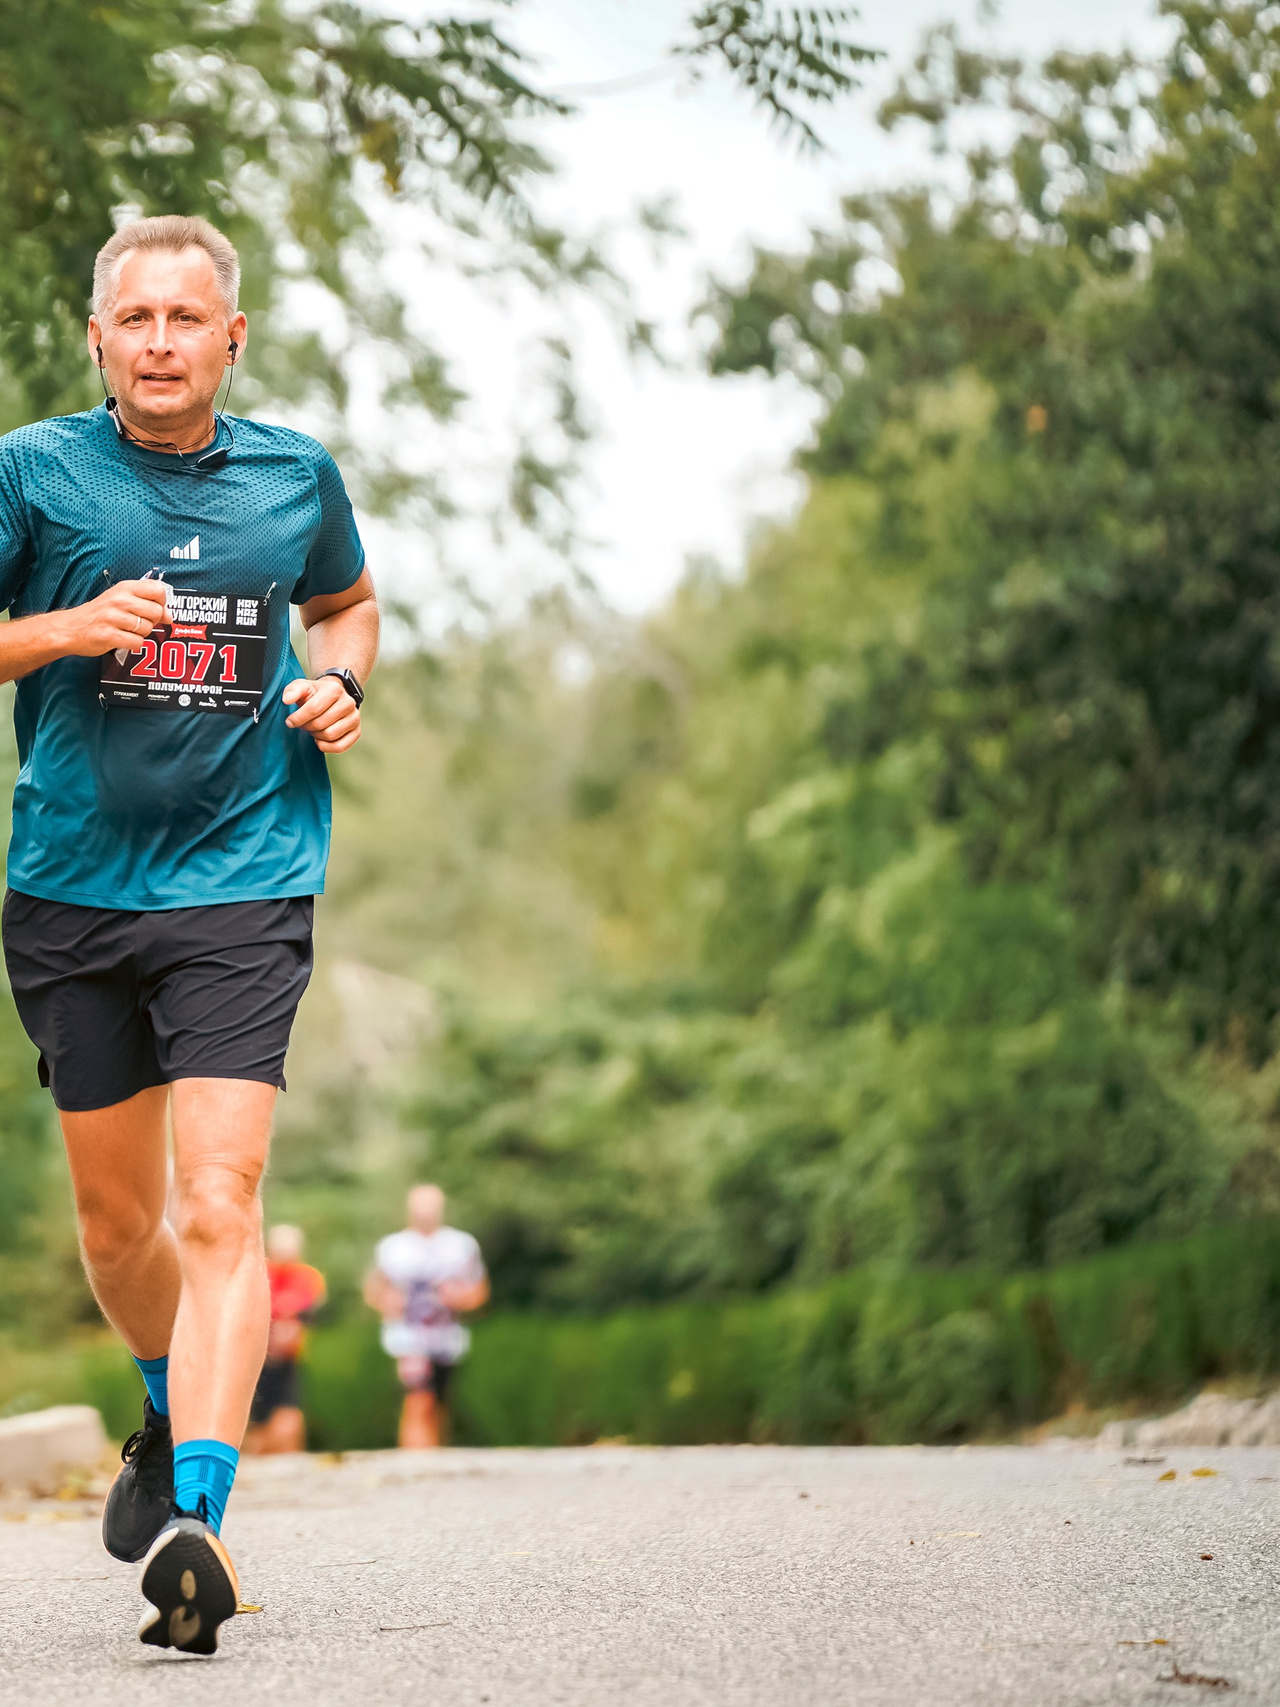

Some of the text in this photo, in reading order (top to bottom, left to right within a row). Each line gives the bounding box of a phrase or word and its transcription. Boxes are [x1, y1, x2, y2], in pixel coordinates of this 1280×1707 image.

[169, 595, 227, 612] ИГОРСКИЙ
[130, 639, 237, 683] 2071
[147, 681, 223, 695] ПОЛУМАРАФОН
